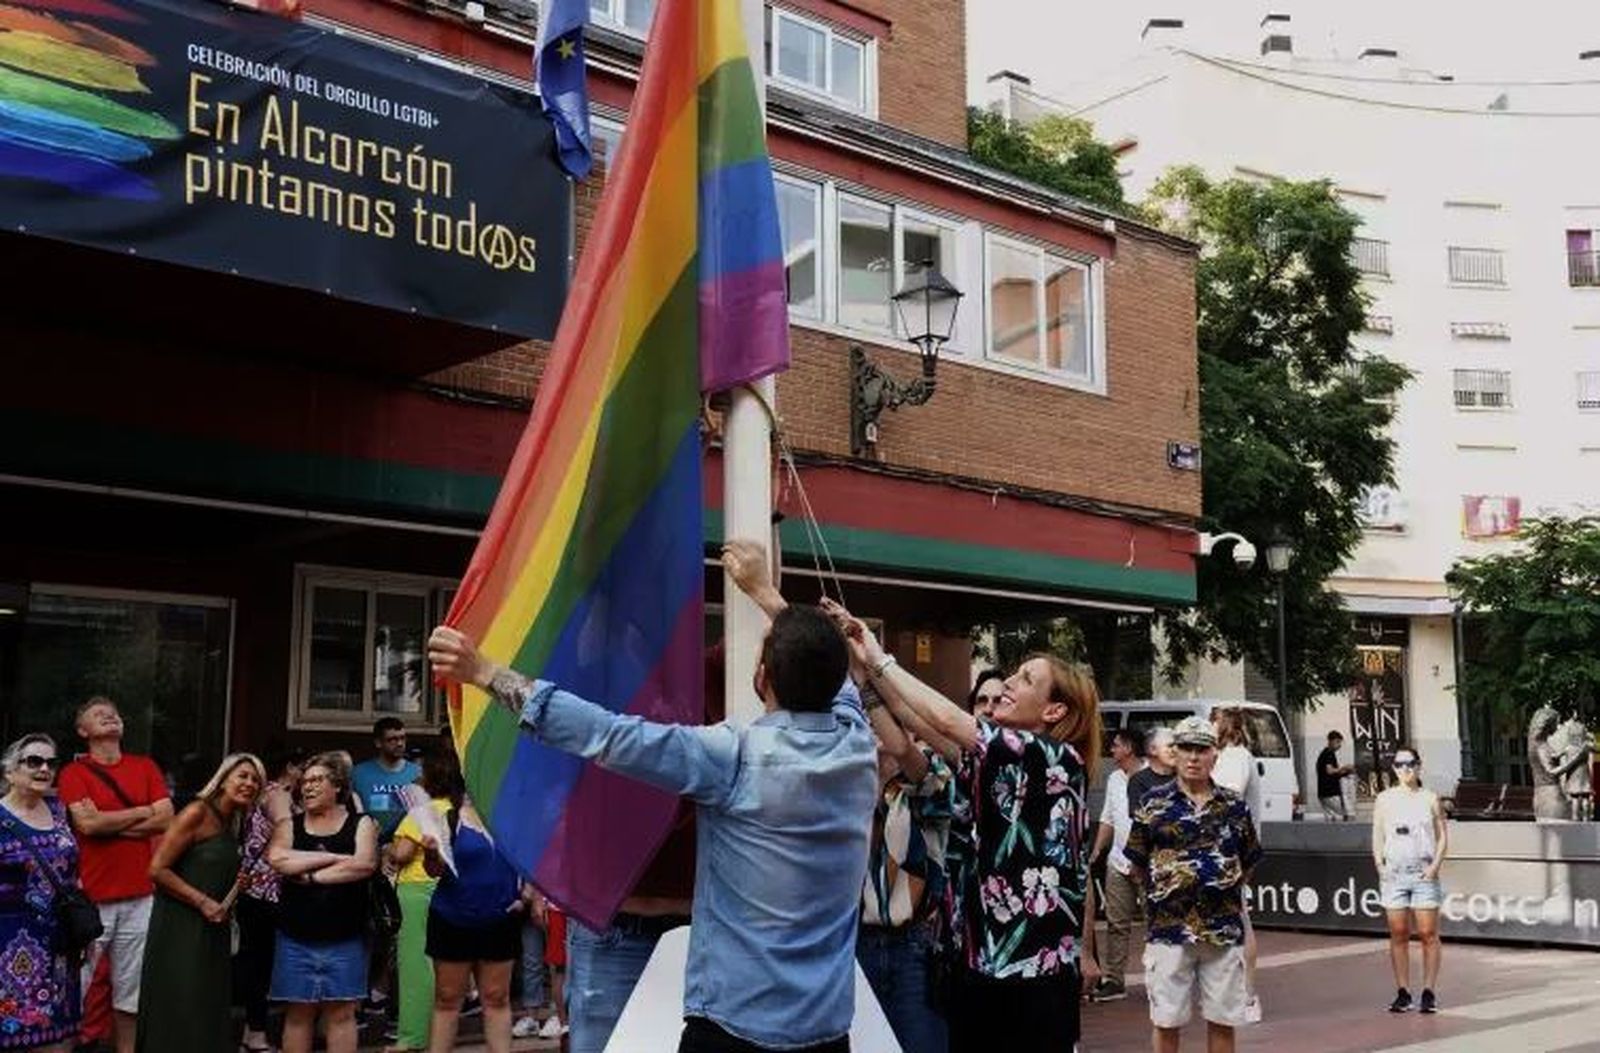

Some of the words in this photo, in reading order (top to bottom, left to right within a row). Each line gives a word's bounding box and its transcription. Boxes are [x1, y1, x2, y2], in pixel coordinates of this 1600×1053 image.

[187, 43, 290, 88] CELEBRACIÓN
[294, 73, 320, 98] DEL
[324, 82, 391, 117] ORGULLO
[188, 71, 240, 146] En
[260, 95, 452, 199] Alcorcón
[185, 145, 396, 239] pintamos
[1365, 740, 1391, 751] CTY
[1332, 876, 1382, 917] de
